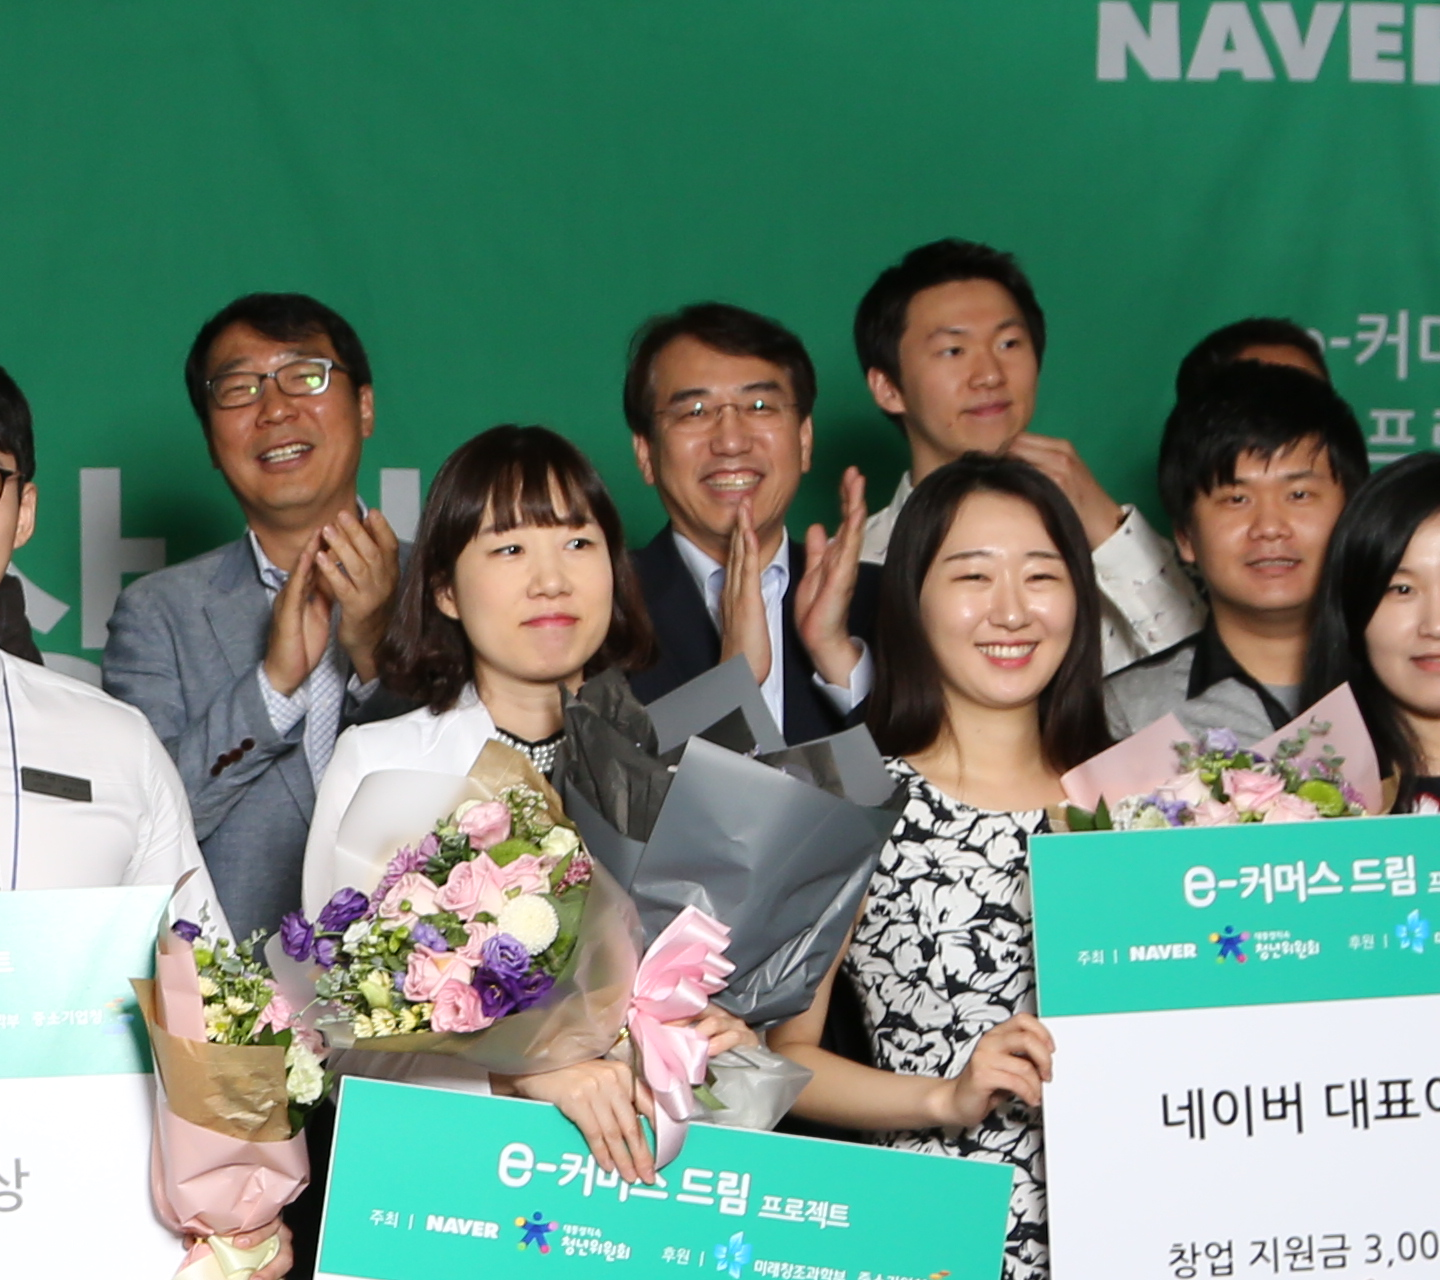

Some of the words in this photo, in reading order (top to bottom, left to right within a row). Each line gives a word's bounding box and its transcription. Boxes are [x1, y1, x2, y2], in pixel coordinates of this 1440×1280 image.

[1183, 860, 1344, 908] e-커머스
[1350, 854, 1417, 897] 드림
[1129, 942, 1198, 962] NAVER
[1162, 1082, 1305, 1140] 네이버
[676, 1167, 751, 1216] 드림
[757, 1195, 850, 1229] 프로젝트
[369, 1209, 400, 1229] 주최
[425, 1214, 500, 1239] NAVER
[561, 1236, 631, 1262] 청년위원회
[661, 1246, 691, 1265] 후원
[1168, 1241, 1234, 1279] 창업
[1249, 1234, 1351, 1275] 지원금
